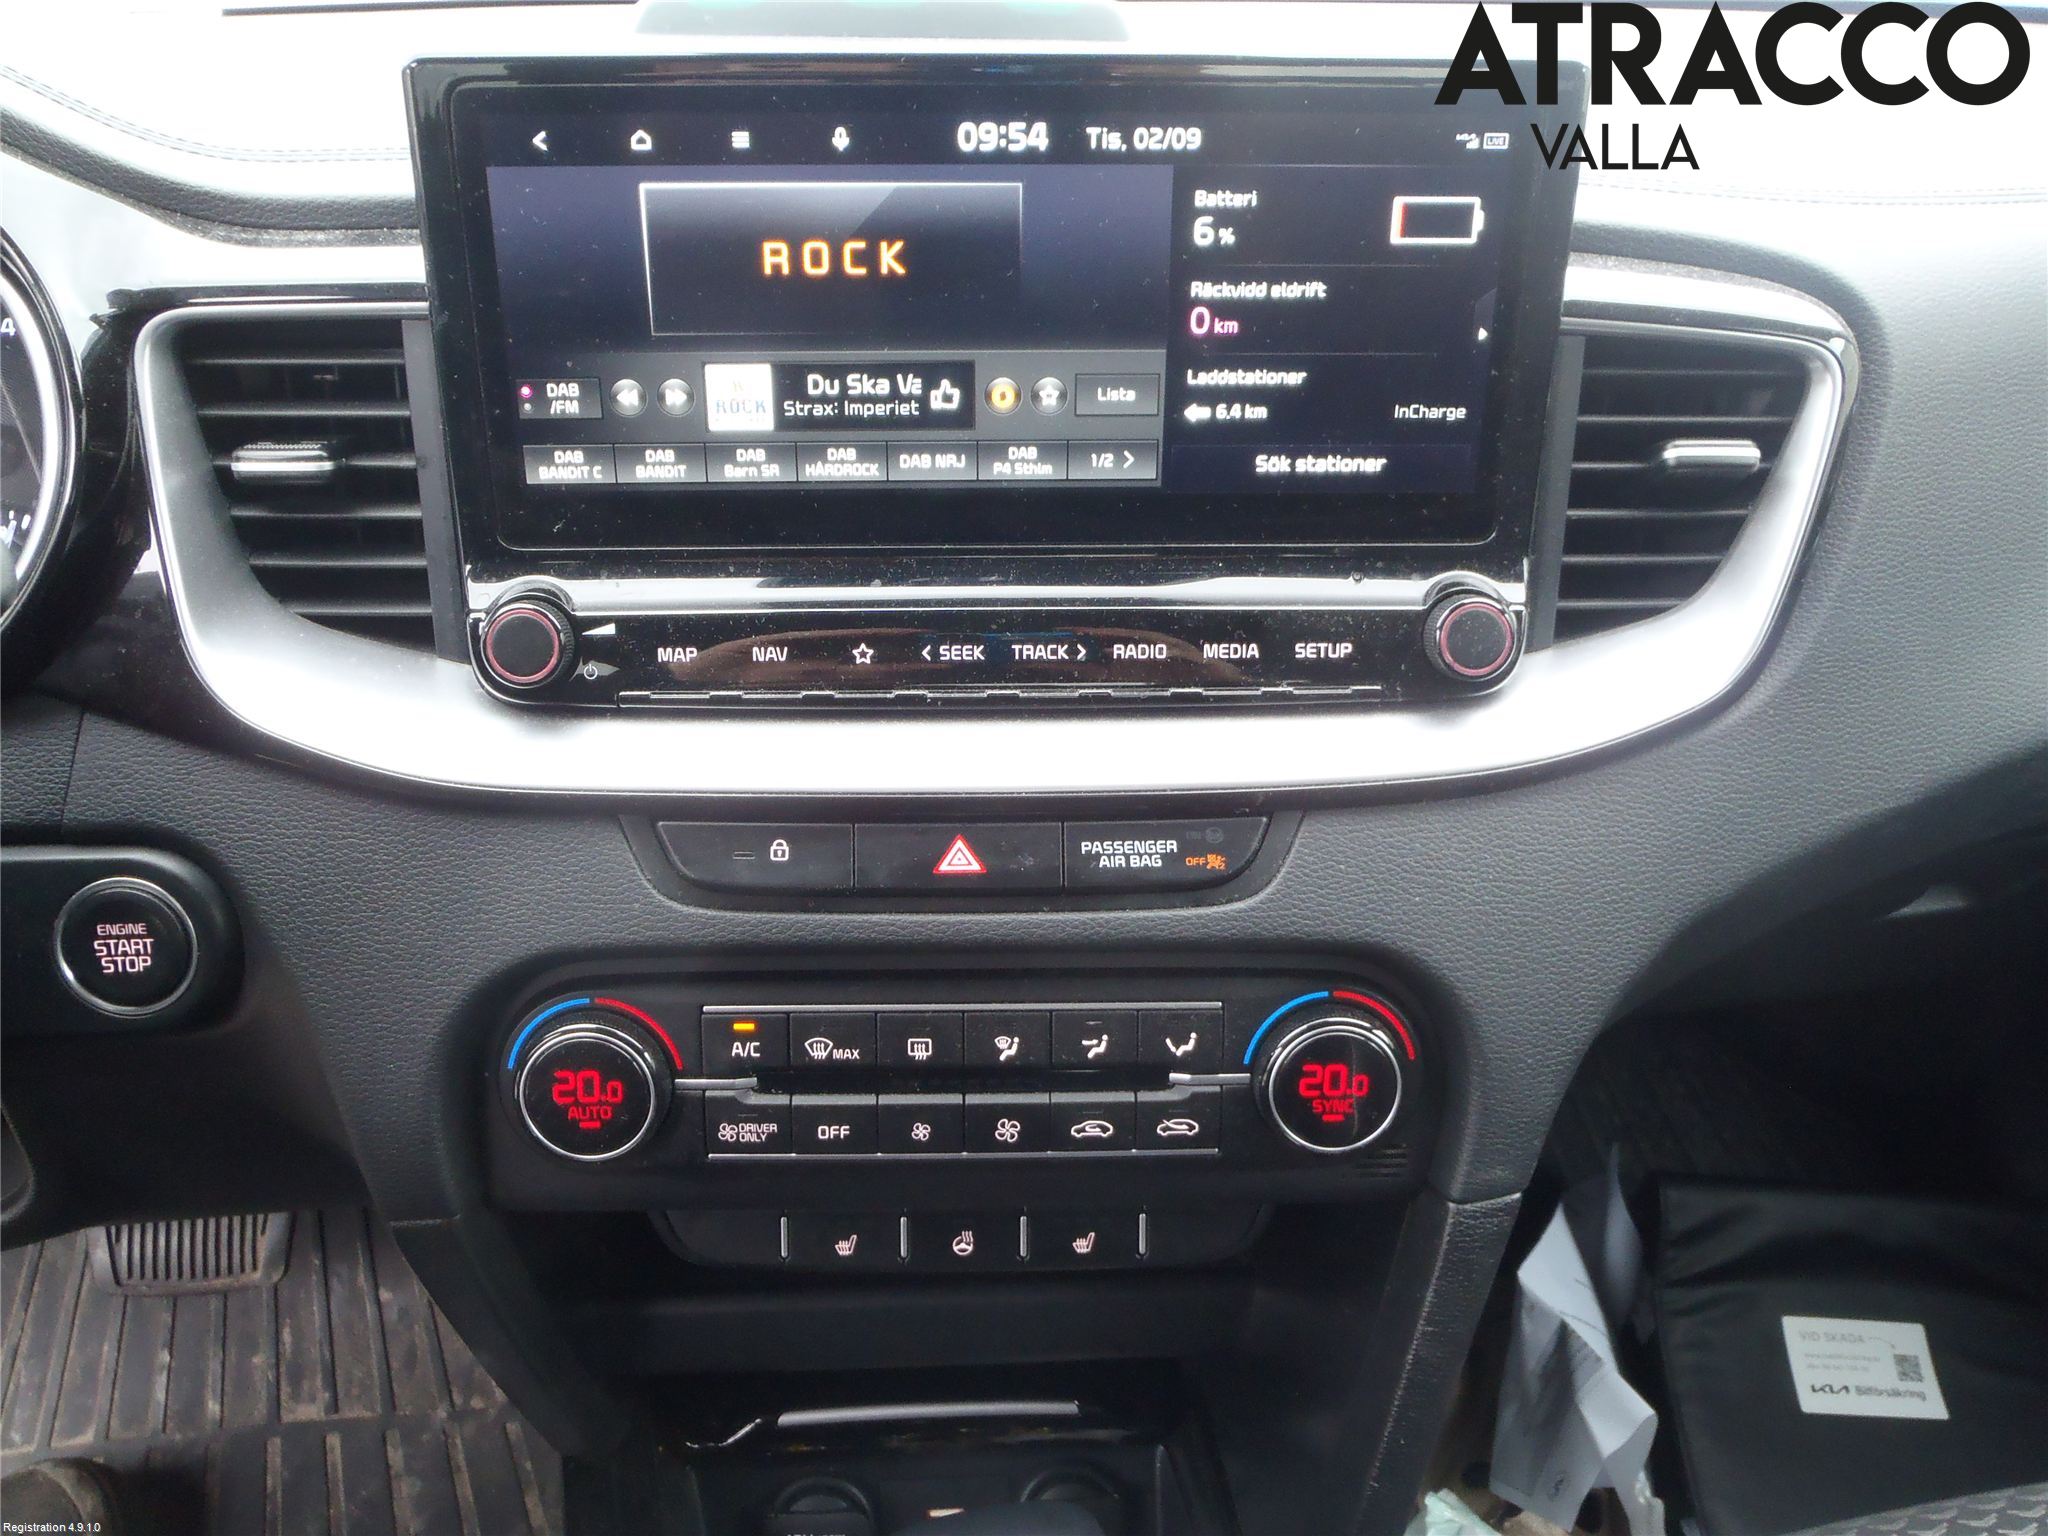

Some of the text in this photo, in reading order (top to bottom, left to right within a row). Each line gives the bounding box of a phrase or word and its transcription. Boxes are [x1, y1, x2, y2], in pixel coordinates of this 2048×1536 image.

[957, 121, 1049, 152] 09:54
[1086, 126, 1202, 152] Tis, 02/09
[1194, 190, 1257, 207] Batteri
[1193, 215, 1215, 246] 6
[761, 239, 907, 276] ROCK
[1190, 281, 1327, 298] Räckvidd eldrift
[1189, 305, 1239, 336] 0 km
[806, 374, 838, 395] Du
[846, 373, 891, 395] Ska
[1187, 369, 1307, 385] Laddstationer
[547, 382, 580, 398] DAB
[1097, 387, 1136, 402] Lista
[550, 400, 580, 415] /FM
[784, 400, 920, 418] Strax: Imperiet
[1215, 403, 1268, 419] 6.4 km
[1394, 404, 1467, 421] InCharge
[554, 450, 584, 464] DAB
[645, 449, 675, 463] DAB
[736, 448, 766, 462] DAB
[827, 447, 857, 461] DAB
[1008, 446, 1038, 460] DAB
[1091, 453, 1114, 468] 1/2
[805, 460, 880, 476] HÅRDROCK
[899, 454, 966, 469] DAB NRJ
[1014, 461, 1052, 475] Sthlm
[1255, 455, 1388, 473] Sök stationer
[538, 465, 602, 479] BANDIT C
[635, 464, 687, 478] BANDIT
[657, 646, 698, 663] MAP
[752, 646, 788, 662] NAV
[939, 645, 985, 661] SEEK
[1011, 644, 1069, 660] TRACK
[1113, 643, 1168, 660] RADIO
[1203, 643, 1260, 659] MEDIA
[1294, 643, 1353, 659] SETUP
[1081, 840, 1177, 854] PASSENGER
[1099, 854, 1162, 868] AIR BAG
[1185, 857, 1206, 867] OFF
[96, 923, 148, 936] ENGINE
[93, 939, 154, 956] START
[101, 956, 151, 973] STOP
[731, 1042, 761, 1058] A/C
[832, 1048, 860, 1060] MAX
[552, 1070, 624, 1105] 20.0
[1299, 1063, 1369, 1097] 20.0
[567, 1106, 613, 1120] AUTO
[1311, 1098, 1355, 1113] SYNC
[738, 1123, 778, 1133] DRIVER
[817, 1125, 850, 1140] OFF
[739, 1132, 768, 1143] ONLY
